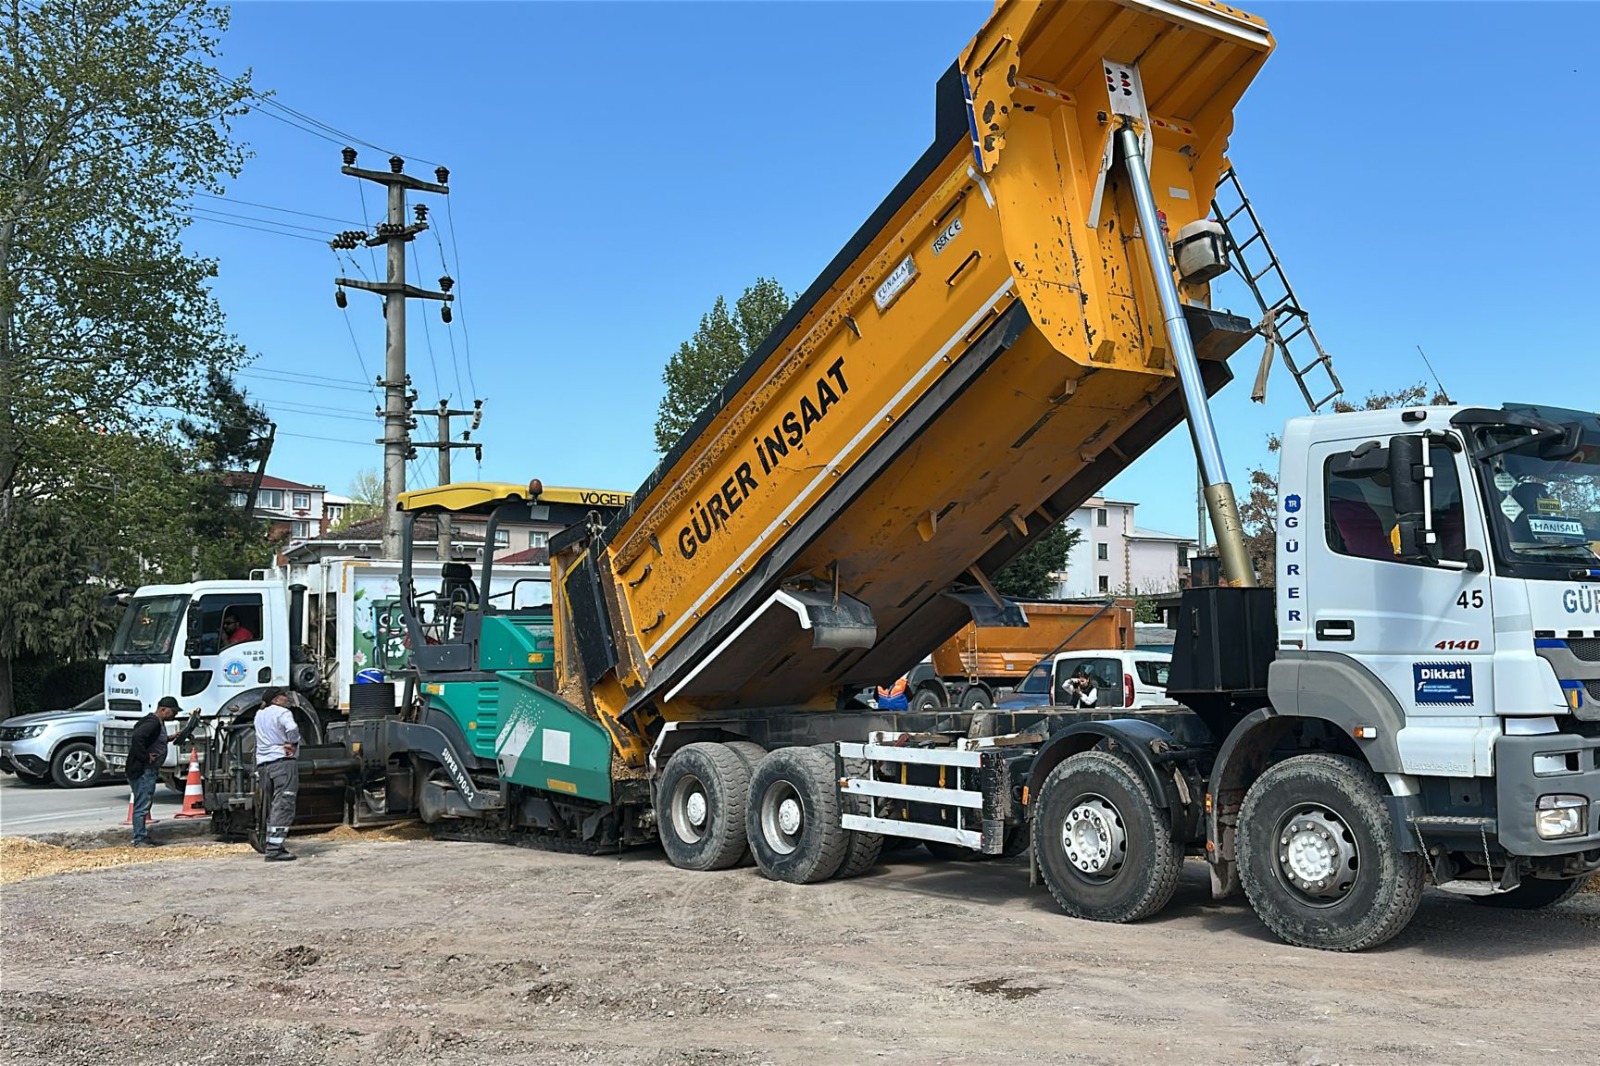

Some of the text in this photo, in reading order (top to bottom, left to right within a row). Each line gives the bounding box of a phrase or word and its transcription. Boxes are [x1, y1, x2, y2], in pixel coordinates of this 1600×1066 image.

[678, 356, 849, 560] GÜRER İNŞAAT
[1285, 517, 1301, 621] GÜRER
[1456, 589, 1484, 609] 45
[1435, 640, 1480, 650] 4140
[1421, 669, 1465, 679] Dikkat!
[442, 748, 474, 802] SUPER 1900-2
